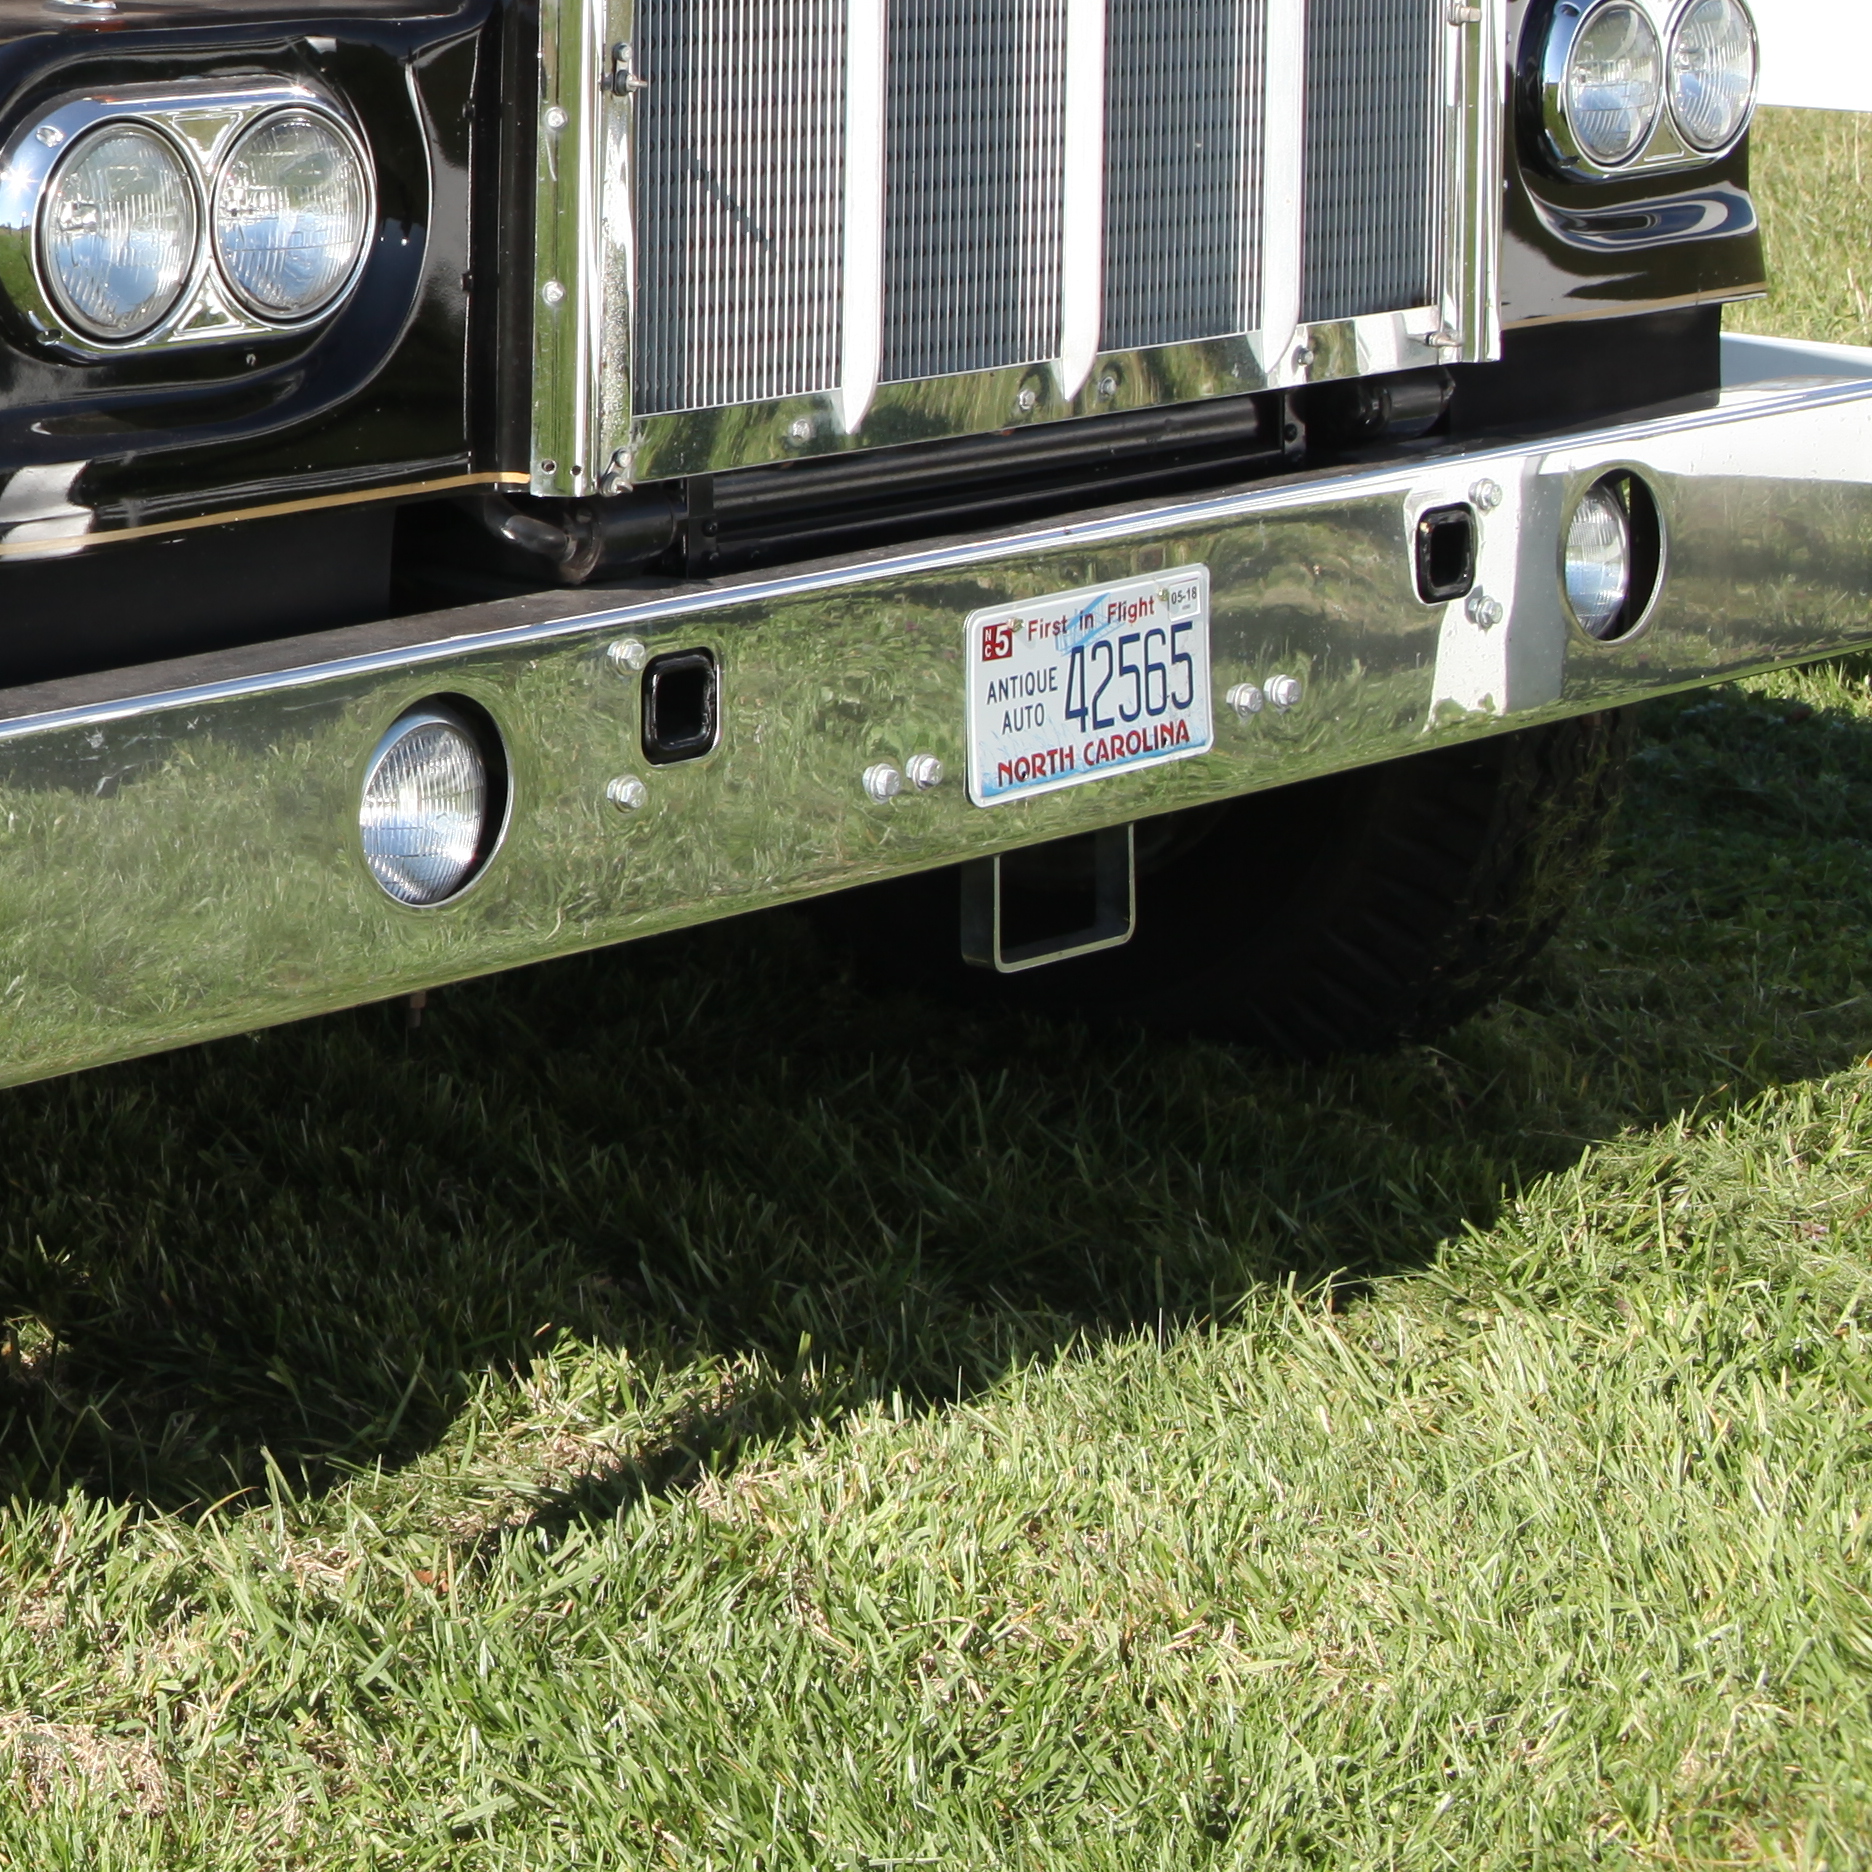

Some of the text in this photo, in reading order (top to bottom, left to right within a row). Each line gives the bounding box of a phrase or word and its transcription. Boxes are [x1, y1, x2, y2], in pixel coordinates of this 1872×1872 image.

[1171, 586, 1197, 604] 05-18
[1028, 595, 1155, 641] First in Flight
[994, 623, 1010, 657] 5
[986, 666, 1057, 704] ANTIQUE
[1064, 620, 1195, 733] 42565
[1002, 702, 1045, 735] AUTO
[997, 718, 1190, 788] NORTH CAROLINA
